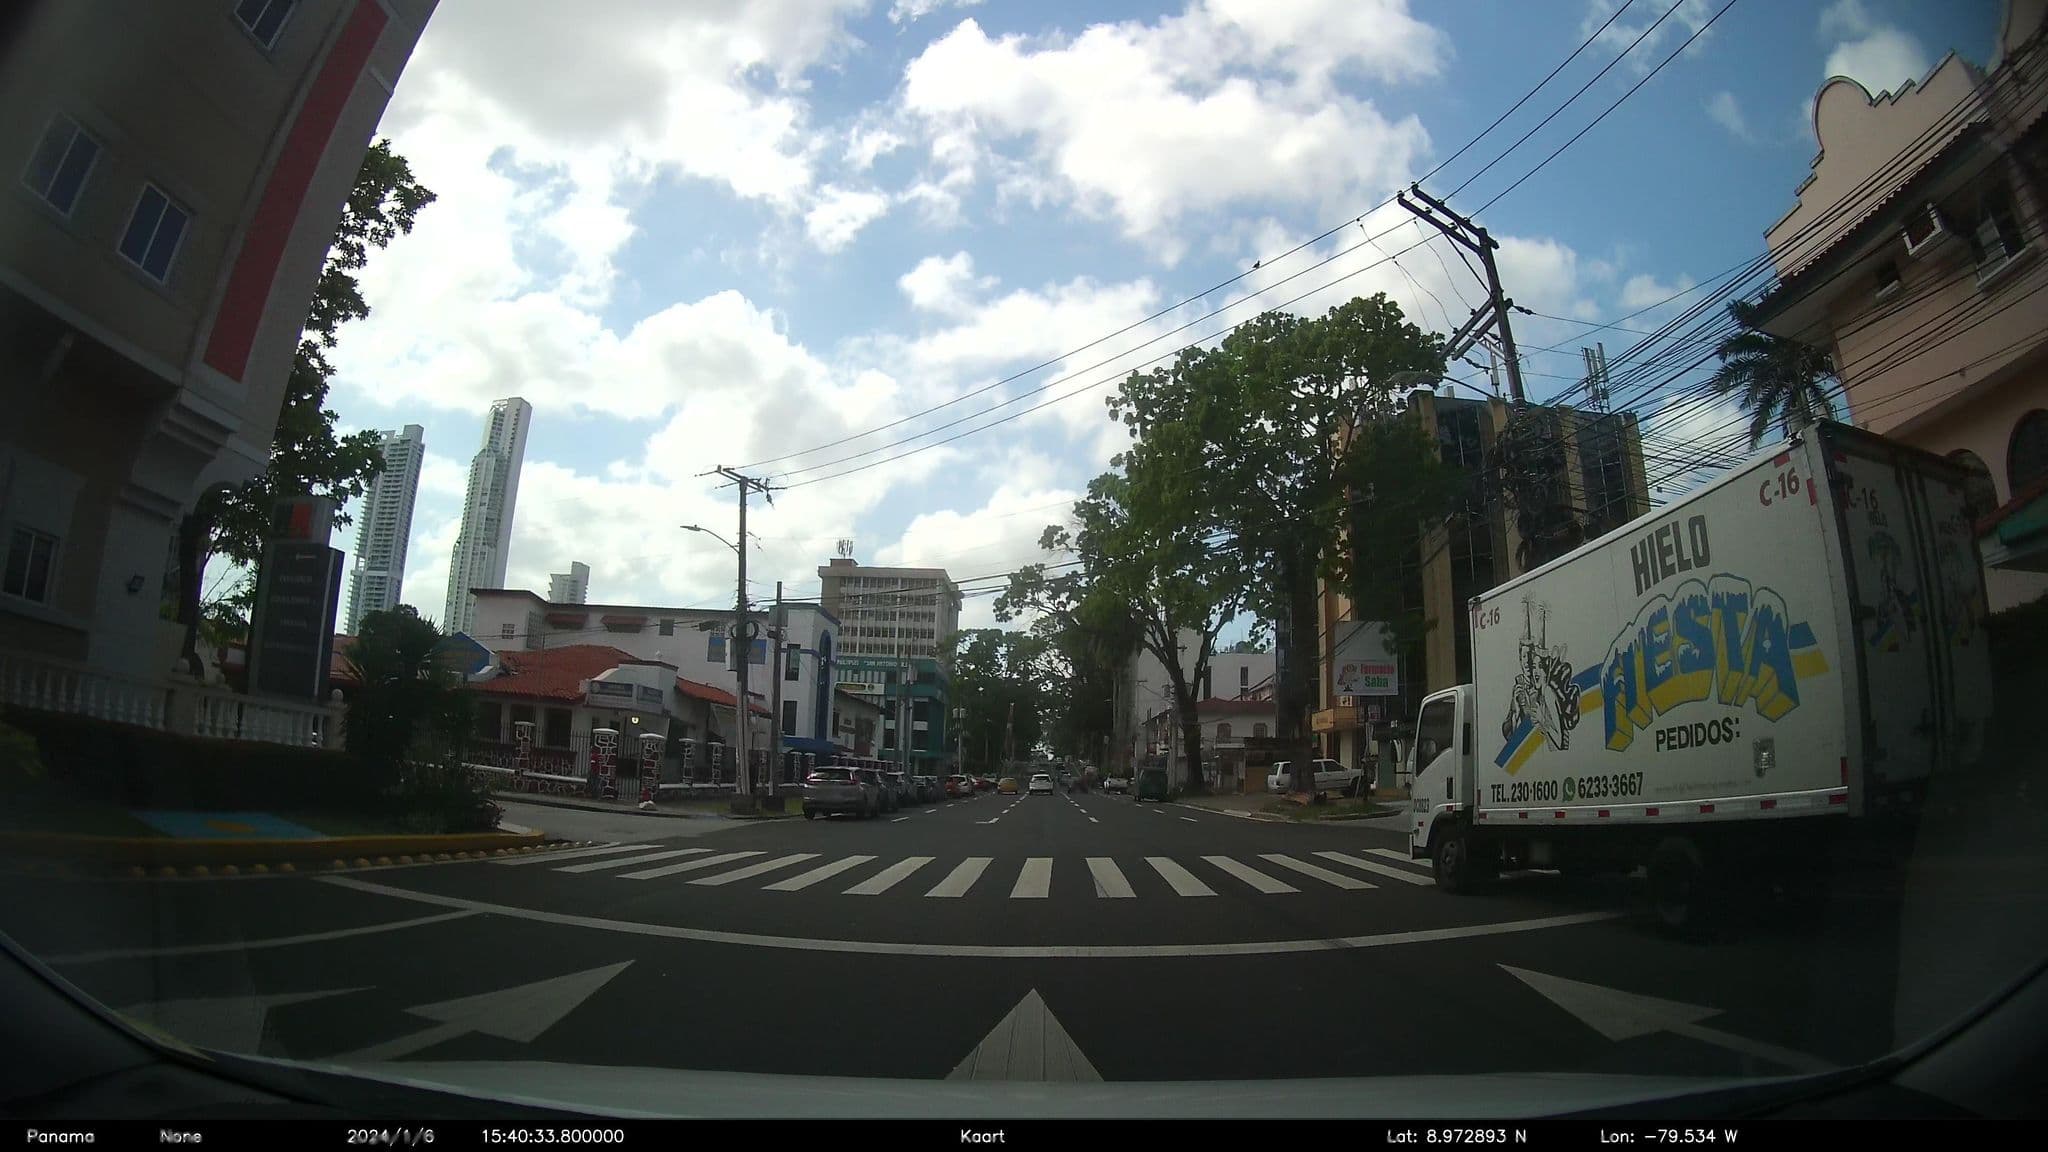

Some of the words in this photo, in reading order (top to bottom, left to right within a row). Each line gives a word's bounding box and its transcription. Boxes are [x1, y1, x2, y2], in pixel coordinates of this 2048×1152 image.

[1759, 467, 1800, 507] C-16
[1630, 514, 1711, 597] HIELO
[1479, 606, 1500, 630] C-16
[1365, 675, 1389, 687] Saba
[1601, 576, 1800, 752] FIESTA
[1656, 717, 1740, 752] PEDIDOS:
[1578, 772, 1643, 799] 6233-3667
